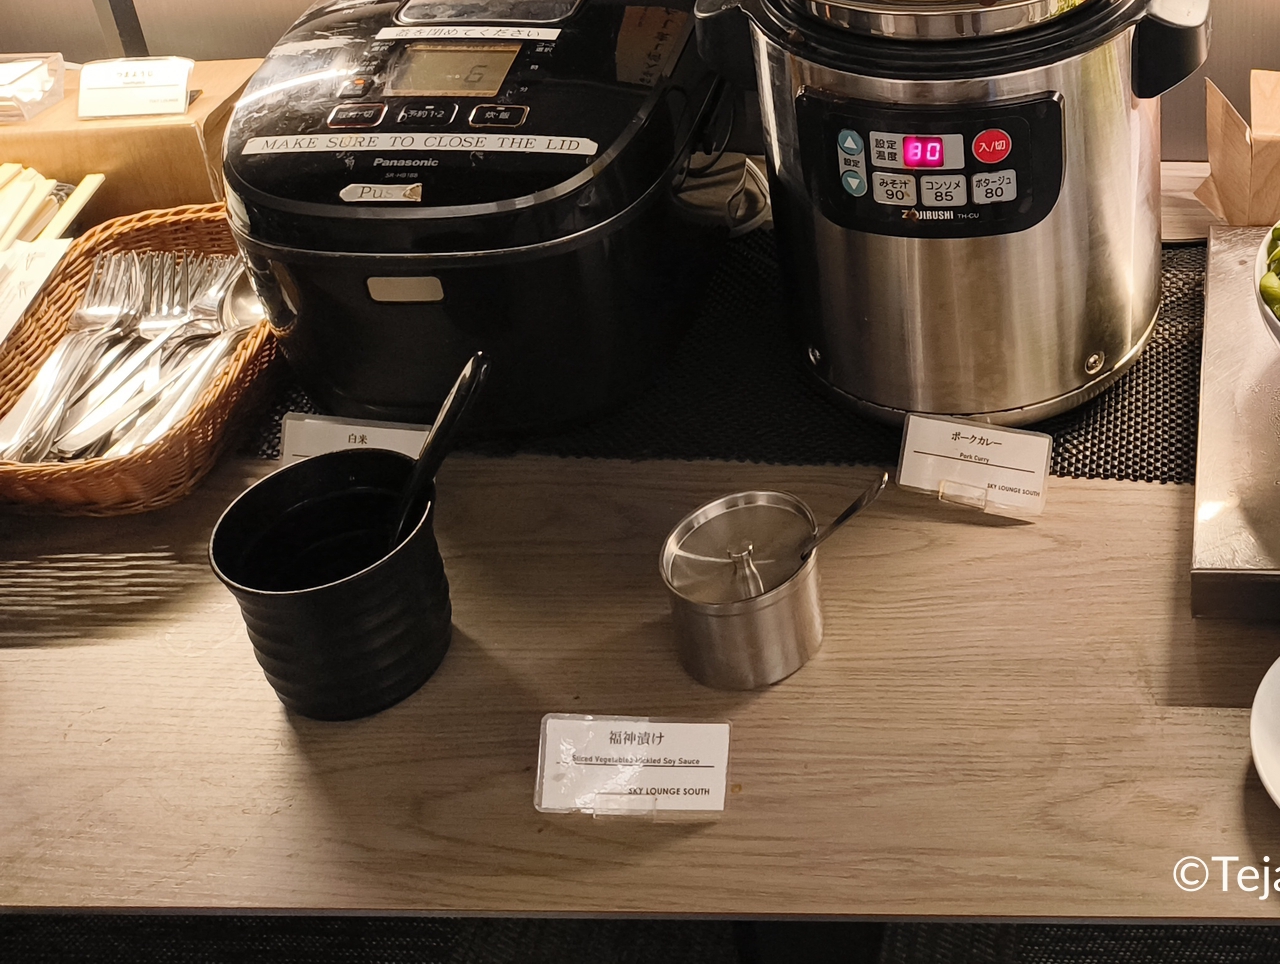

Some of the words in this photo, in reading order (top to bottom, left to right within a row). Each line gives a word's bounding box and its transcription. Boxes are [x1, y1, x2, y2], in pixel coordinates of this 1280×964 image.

[261, 137, 319, 150] MAKE
[326, 136, 379, 149] SURE
[389, 136, 414, 149] TO
[424, 136, 487, 148] CLOSE
[499, 137, 536, 149] THE
[545, 138, 580, 151] LID
[874, 139, 897, 150] 設定
[875, 150, 898, 162] 温度
[373, 157, 439, 167] Panasonic
[879, 178, 910, 189] みそ汁
[925, 180, 961, 191] コンソメ
[975, 176, 1012, 188] ポタージュ
[885, 189, 905, 201] 90
[934, 191, 954, 202] 85
[985, 187, 1004, 198] 80
[348, 433, 368, 445] 白米
[951, 432, 1002, 446] ポークカレー
[959, 452, 973, 460] Pork
[974, 454, 989, 463] Curry
[987, 482, 997, 490] SKY
[998, 484, 1021, 494] LOUNGE
[1022, 488, 1040, 497] SOUTH
[609, 730, 665, 746] 福神漬け
[663, 757, 676, 766] Soy
[683, 788, 710, 796] SOUTH
